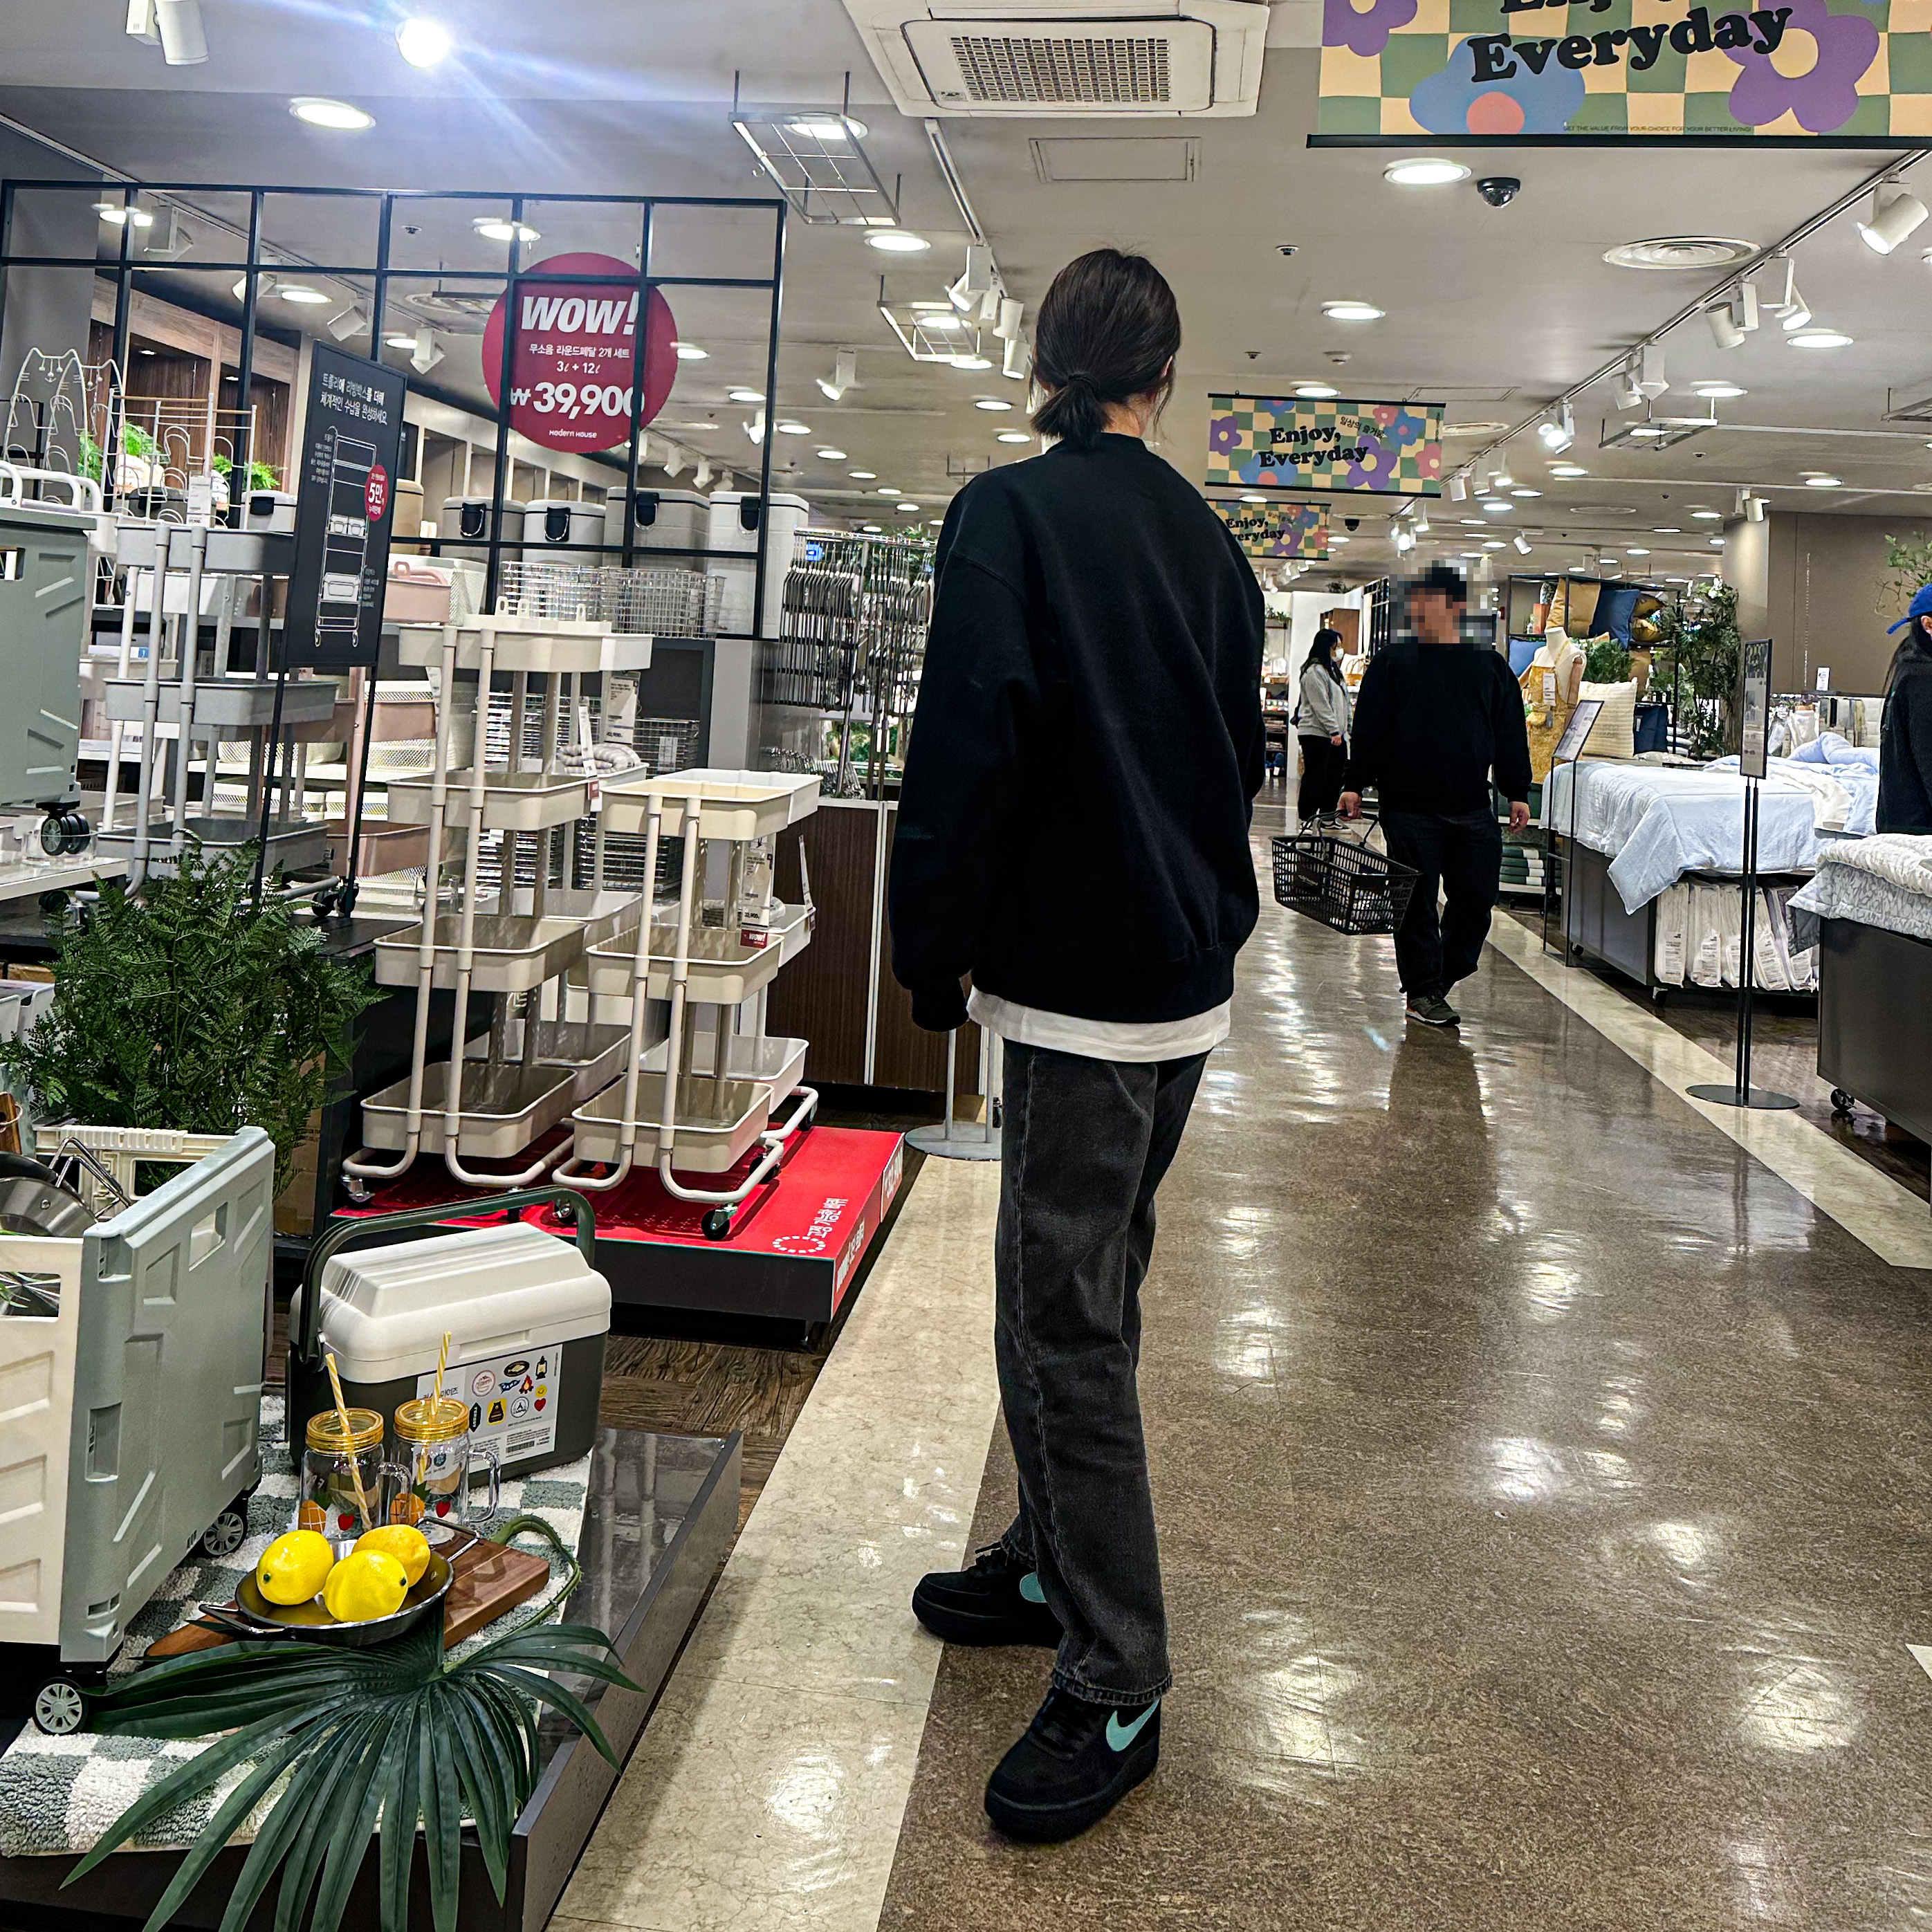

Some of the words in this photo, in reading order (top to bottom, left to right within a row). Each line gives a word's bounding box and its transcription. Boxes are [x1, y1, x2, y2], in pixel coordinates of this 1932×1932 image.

[1467, 7, 1794, 83] Everyday
[521, 291, 640, 335] WOW!
[529, 343, 553, 356] 무소음
[556, 344, 596, 358] 라운드페달
[598, 347, 611, 358] 2개
[614, 347, 630, 358] 세트
[1339, 416, 1362, 431] 일상의
[1269, 425, 1341, 446] Enjoy,
[1258, 445, 1370, 468] Everyday
[1225, 517, 1269, 530] Enjoy,
[1232, 528, 1285, 542] veryday
[807, 1225, 833, 1238] 고정
